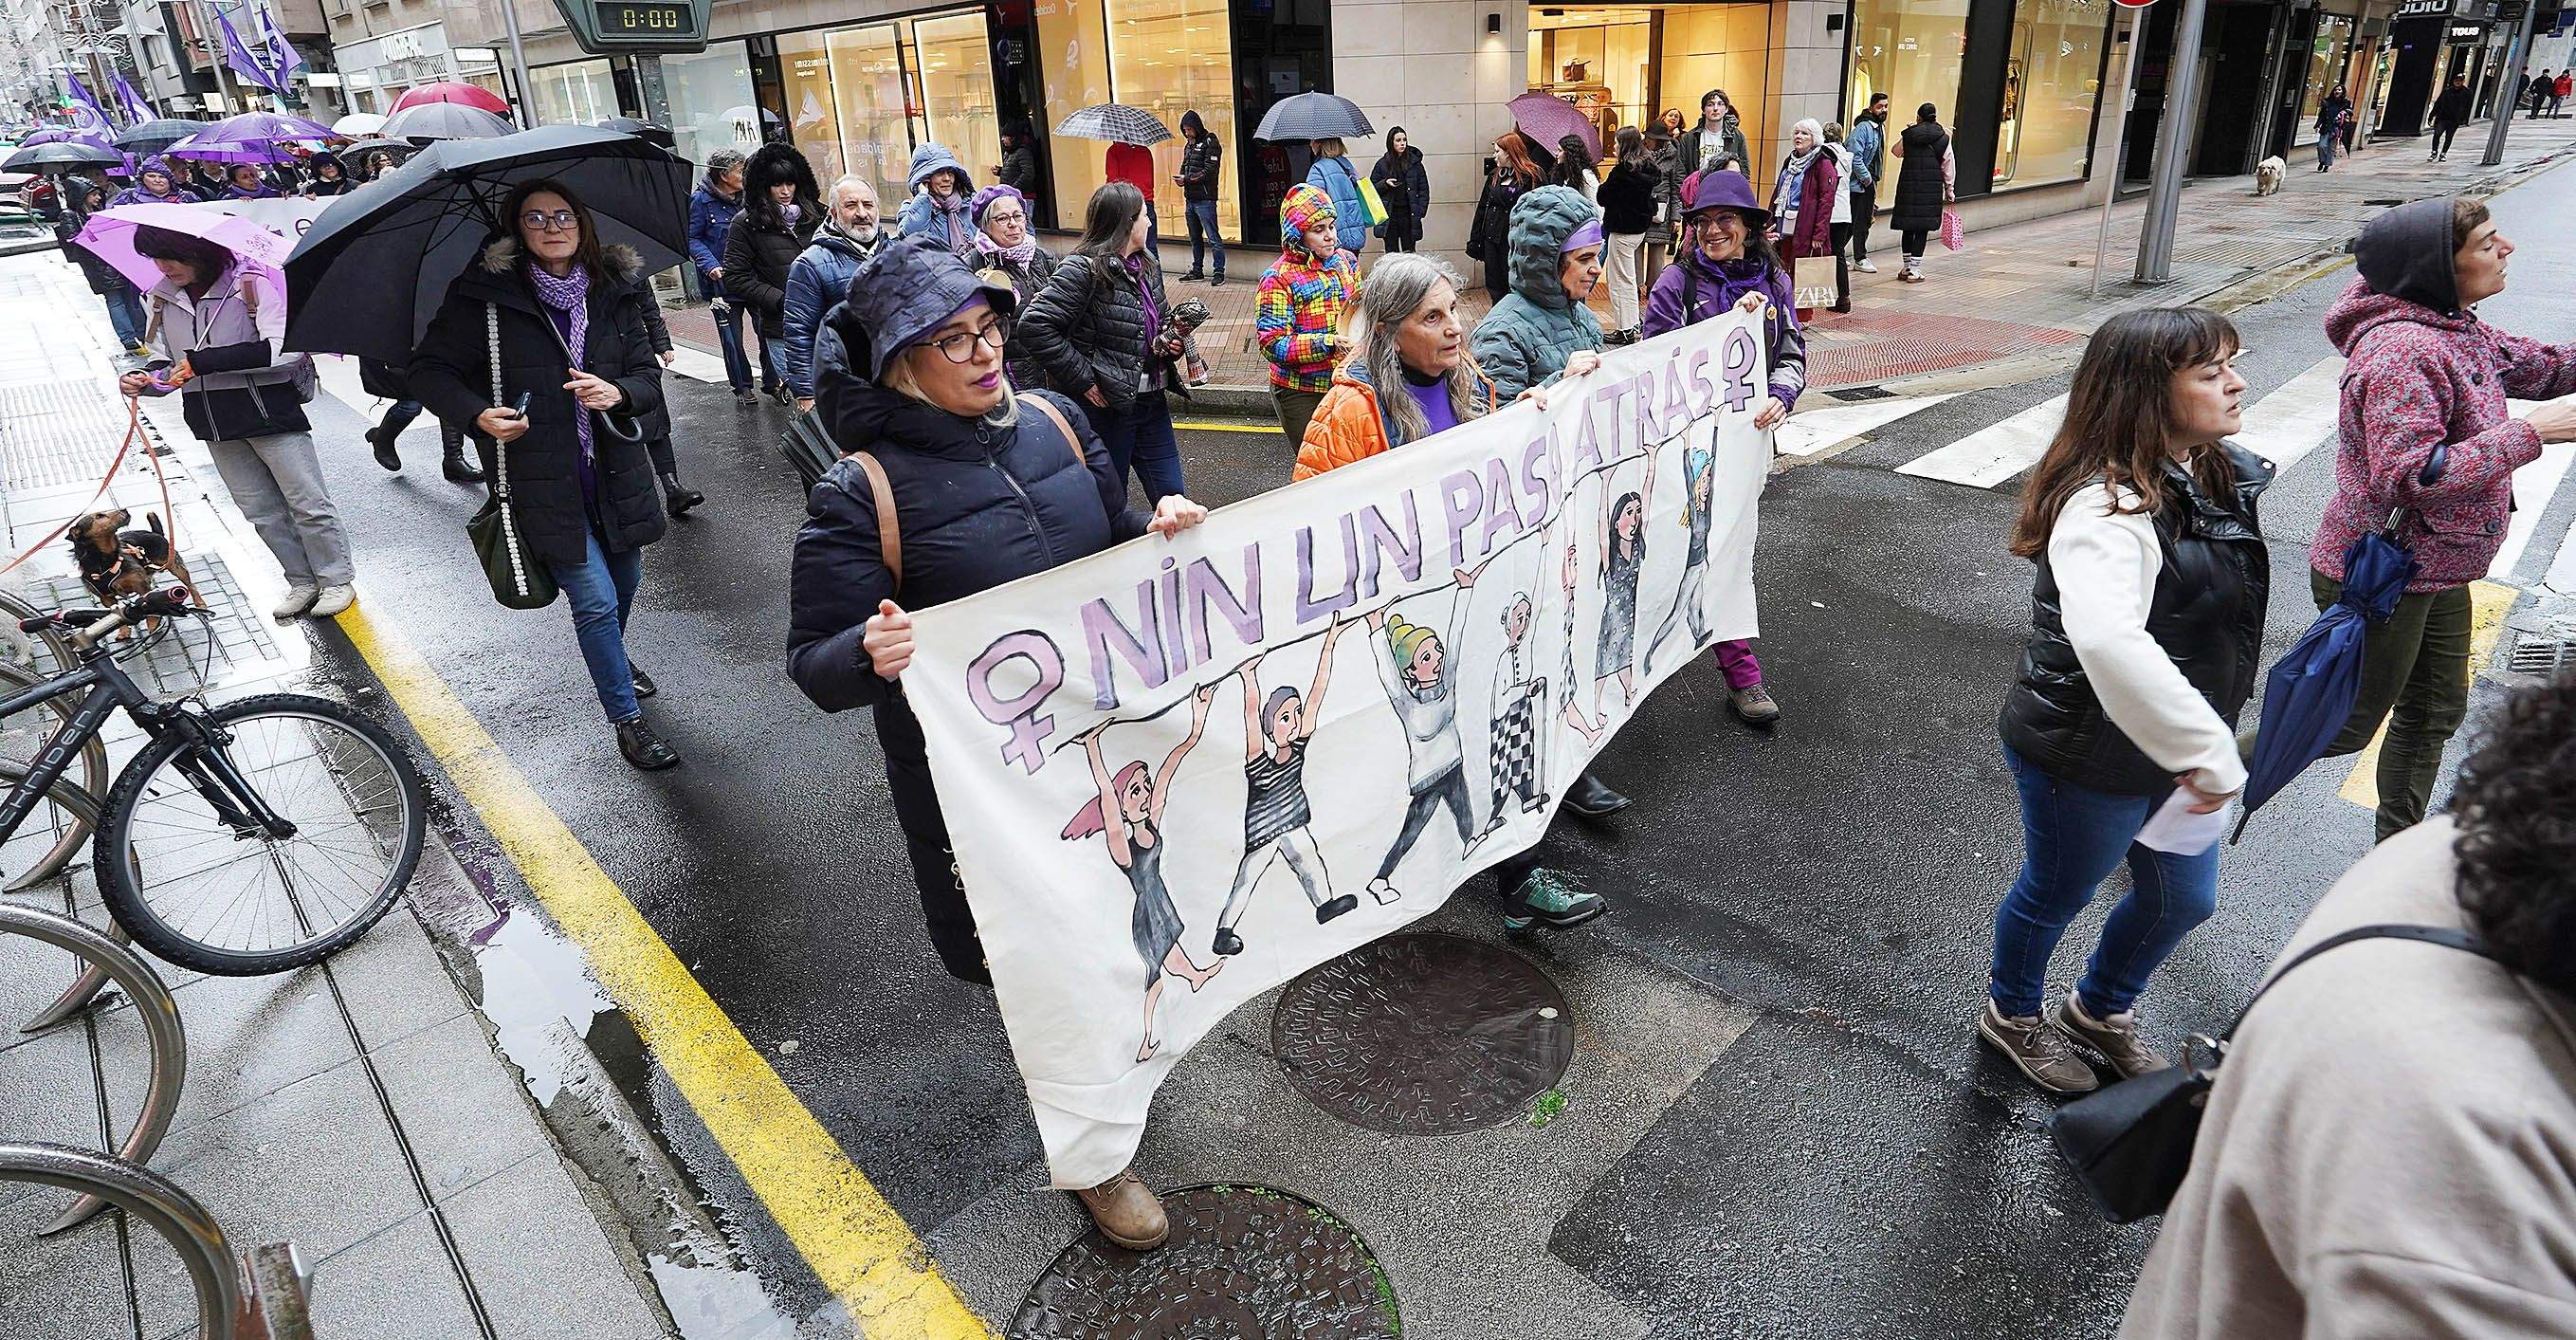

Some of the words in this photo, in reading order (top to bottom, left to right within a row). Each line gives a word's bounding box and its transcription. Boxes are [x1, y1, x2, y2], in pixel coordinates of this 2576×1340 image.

[623, 9, 677, 28] 0:00
[2451, 27, 2479, 36] TOUS
[1795, 286, 1837, 306] ZARA
[1295, 488, 1421, 626] UN
[1572, 346, 1714, 481] ATRÁS
